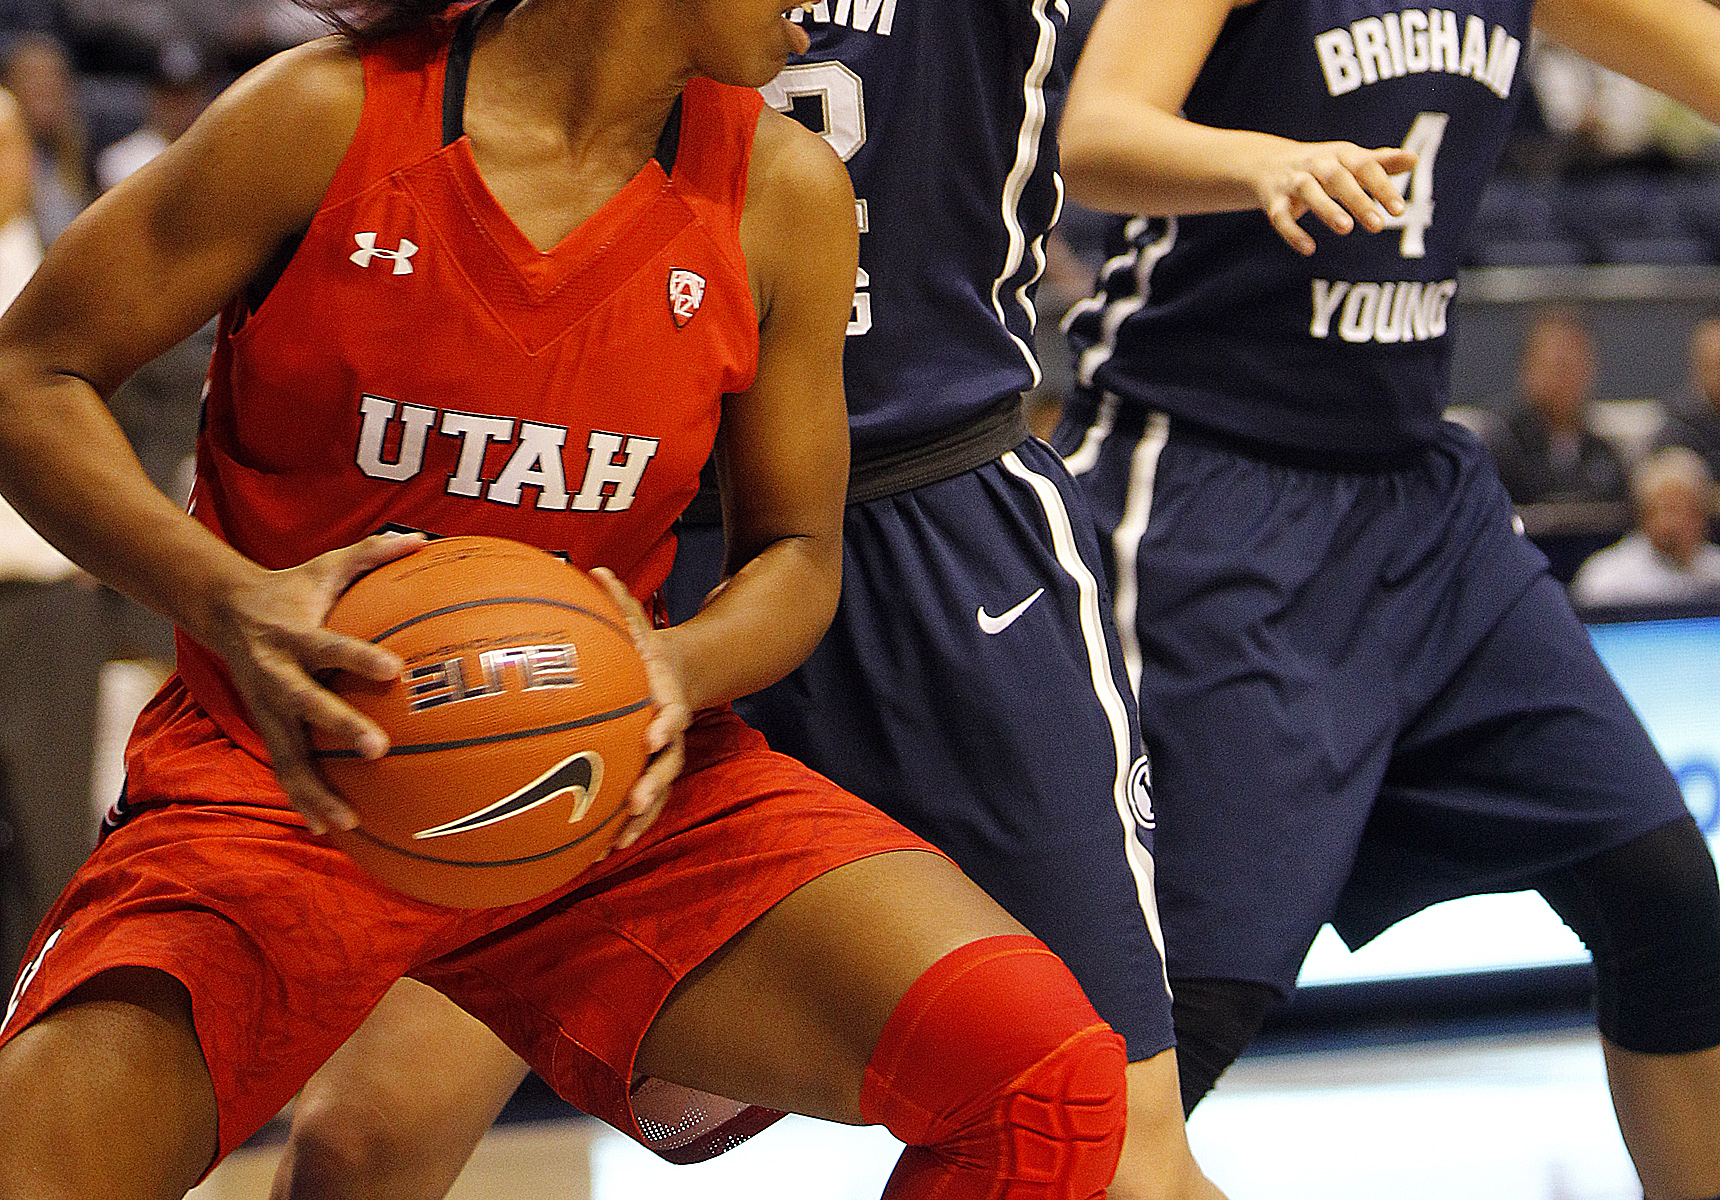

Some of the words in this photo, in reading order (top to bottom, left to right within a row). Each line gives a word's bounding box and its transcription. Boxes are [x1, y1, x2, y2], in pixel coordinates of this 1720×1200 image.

[1314, 8, 1521, 98] BRIGHAM
[1373, 111, 1450, 258] 4
[1310, 278, 1458, 344] YOUNG
[356, 392, 661, 514] UTAH
[401, 643, 583, 715] ELITE
